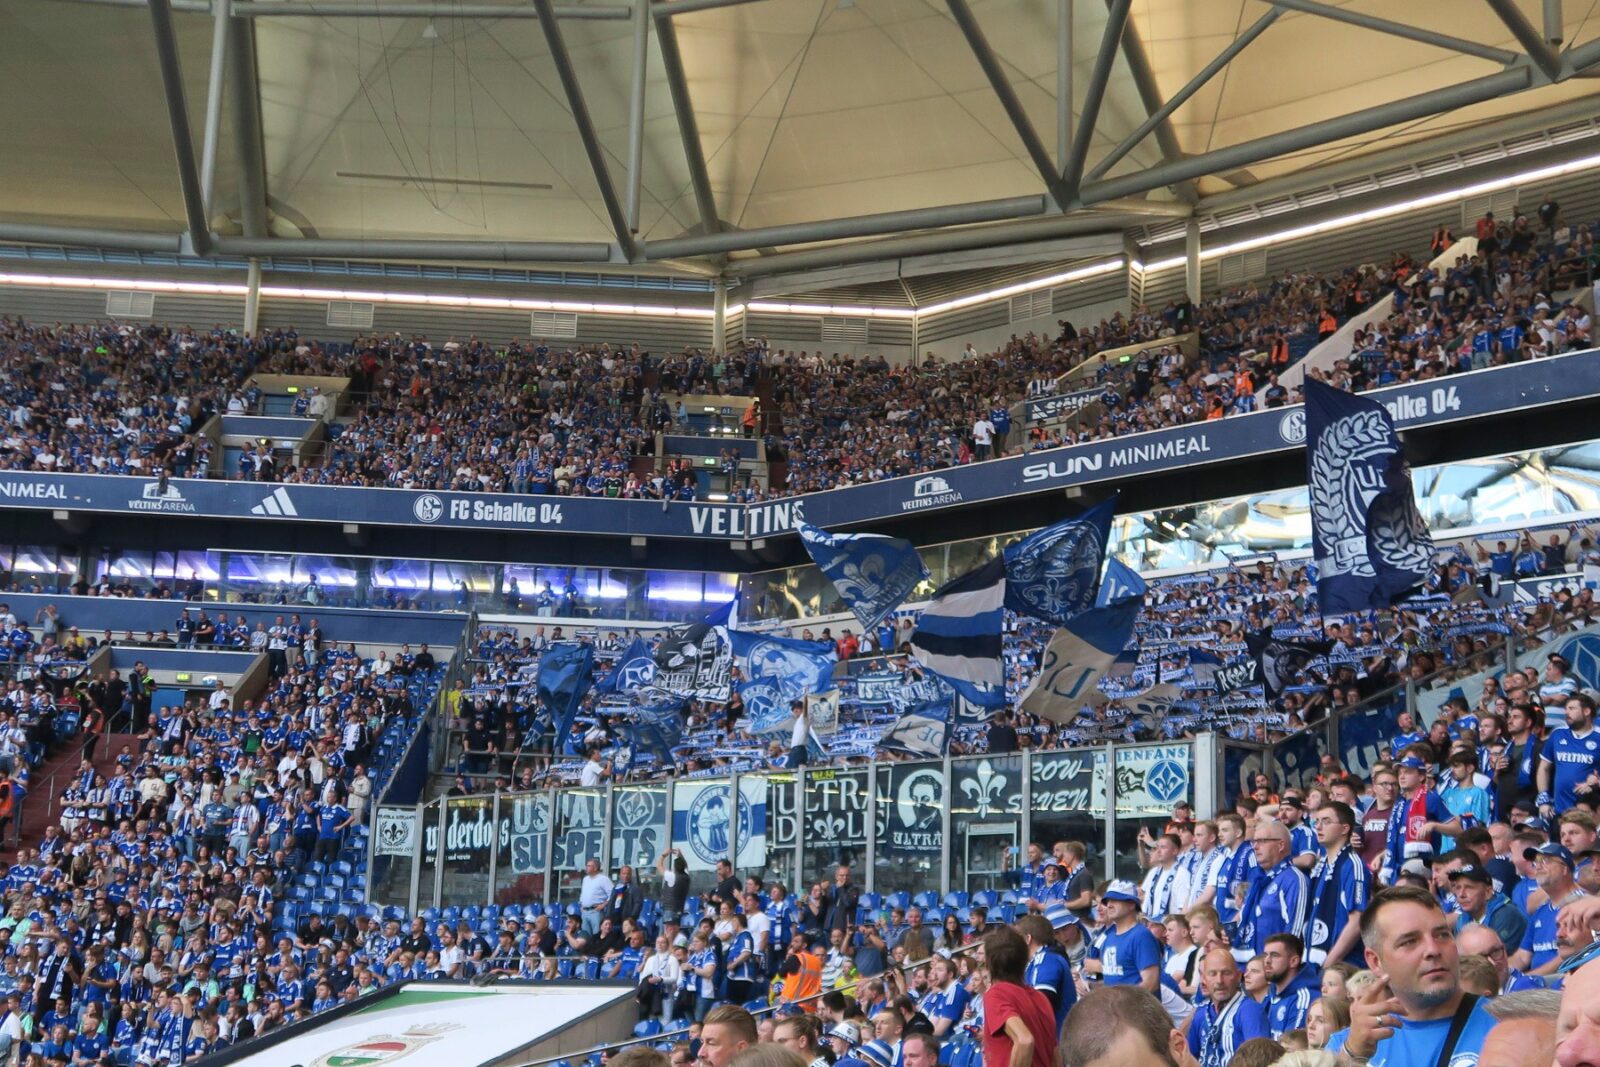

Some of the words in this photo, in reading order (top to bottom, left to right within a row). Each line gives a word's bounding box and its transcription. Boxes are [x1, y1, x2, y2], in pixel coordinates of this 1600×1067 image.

[1385, 394, 1428, 421] alke
[1432, 386, 1461, 414] 04
[1023, 453, 1103, 483] SUN
[1109, 434, 1211, 468] MINIMEAL
[128, 500, 162, 510] VELTINS
[163, 501, 195, 511] ARENA
[450, 499, 470, 520] FC
[473, 500, 536, 523] Schalke
[540, 503, 563, 524] 04
[902, 497, 933, 510] VELTINS
[933, 492, 963, 504] ARENA
[689, 500, 804, 535] VELTINS
[1094, 747, 1187, 763] LIIENFANS
[1556, 751, 1594, 765] VELTINS
[778, 778, 886, 815] ULTRA
[426, 808, 510, 852] uderdos
